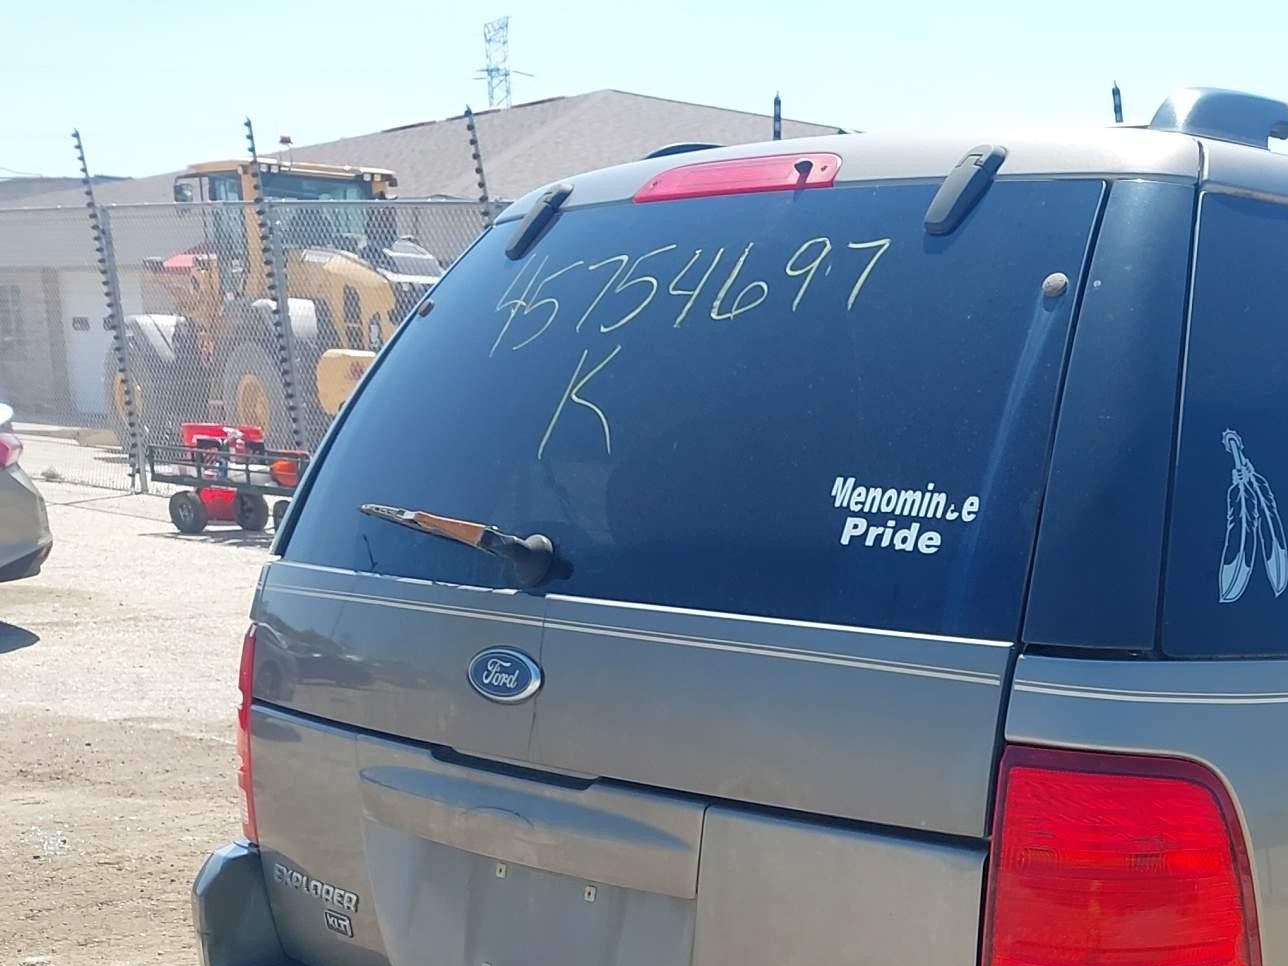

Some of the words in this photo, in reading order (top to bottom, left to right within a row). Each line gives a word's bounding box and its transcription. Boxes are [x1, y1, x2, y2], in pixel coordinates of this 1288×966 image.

[489, 237, 892, 358] 45754697
[537, 344, 622, 460] K
[840, 516, 942, 554] Pride
[482, 658, 520, 689] Ford
[273, 863, 360, 913] EXPLORER
